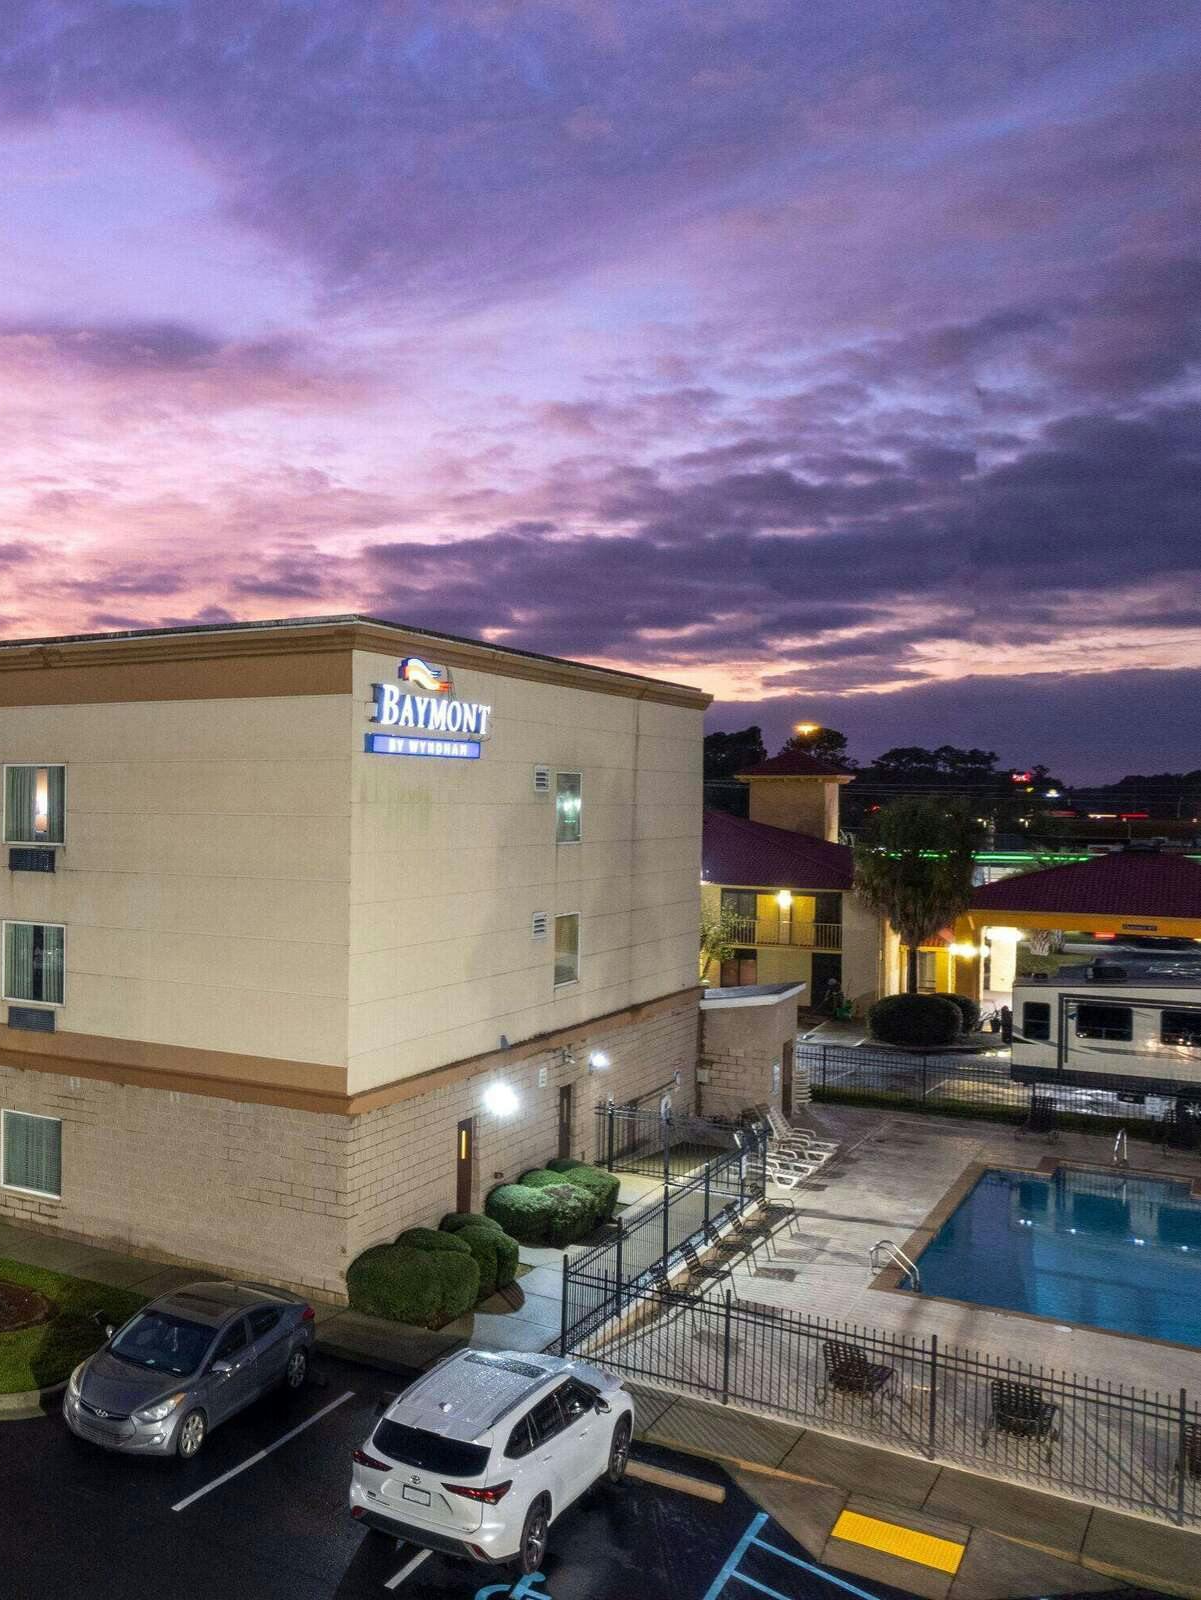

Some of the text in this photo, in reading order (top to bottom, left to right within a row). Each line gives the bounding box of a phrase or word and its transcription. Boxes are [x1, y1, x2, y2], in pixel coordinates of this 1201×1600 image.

[379, 683, 491, 735] BAYMONT
[388, 738, 468, 757] BY WYNDHAM
